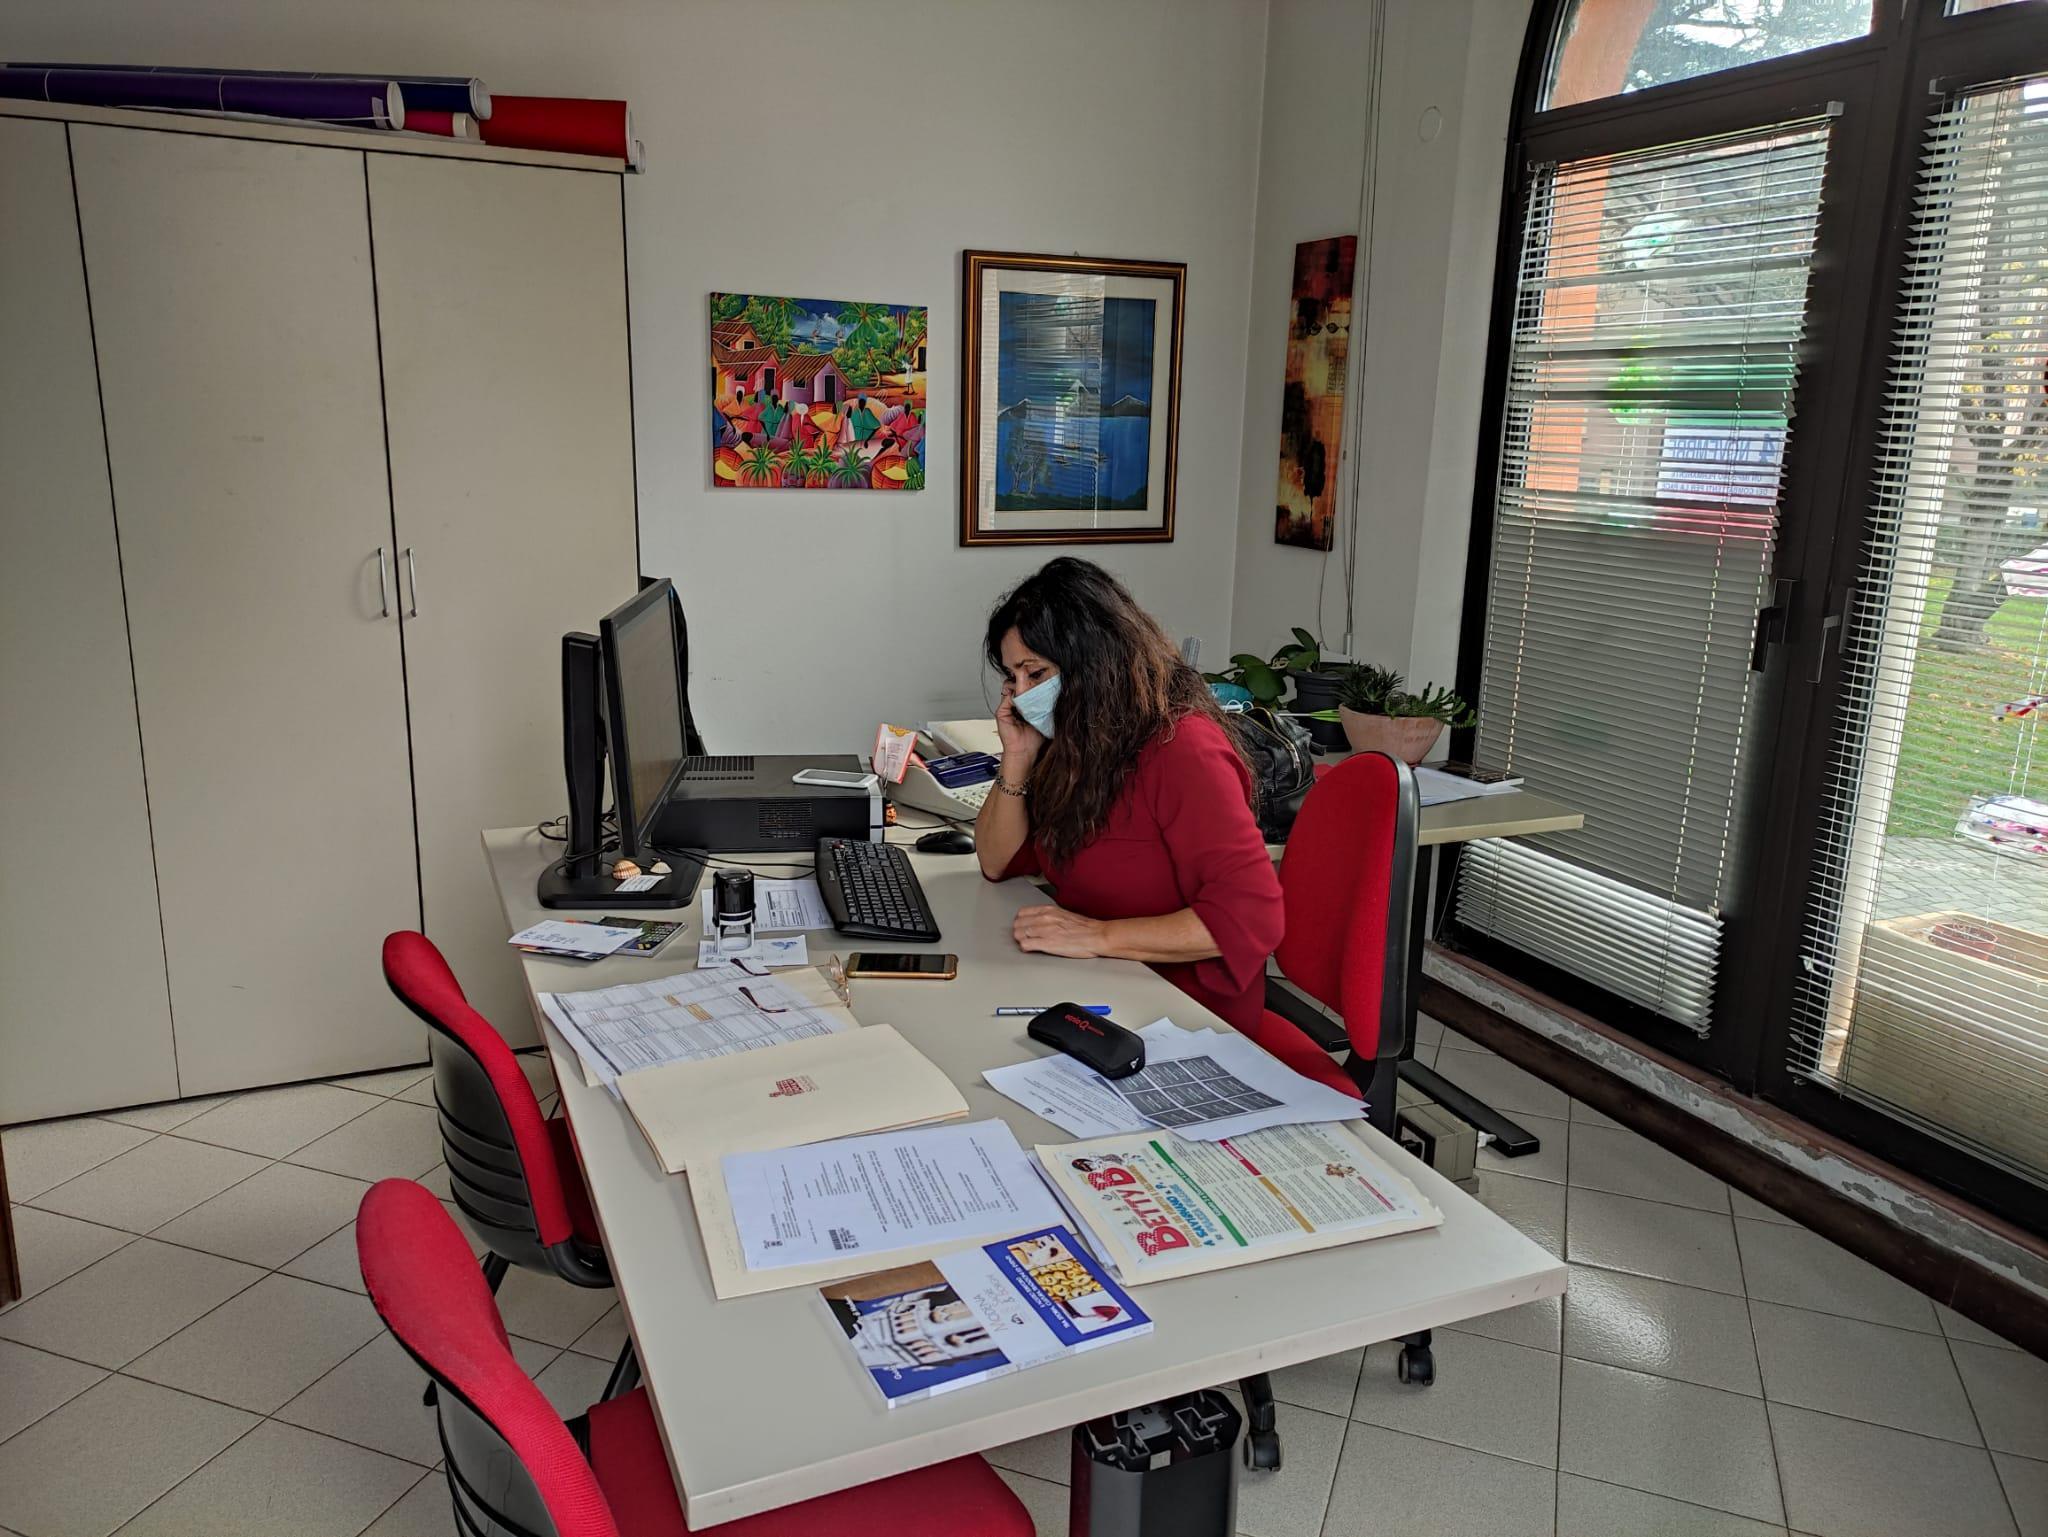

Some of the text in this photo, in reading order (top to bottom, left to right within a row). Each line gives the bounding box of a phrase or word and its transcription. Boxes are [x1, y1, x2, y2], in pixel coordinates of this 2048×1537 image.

[1087, 1167, 1193, 1256] BETTY B
[1165, 1195, 1209, 1238] SAVIGNANO
